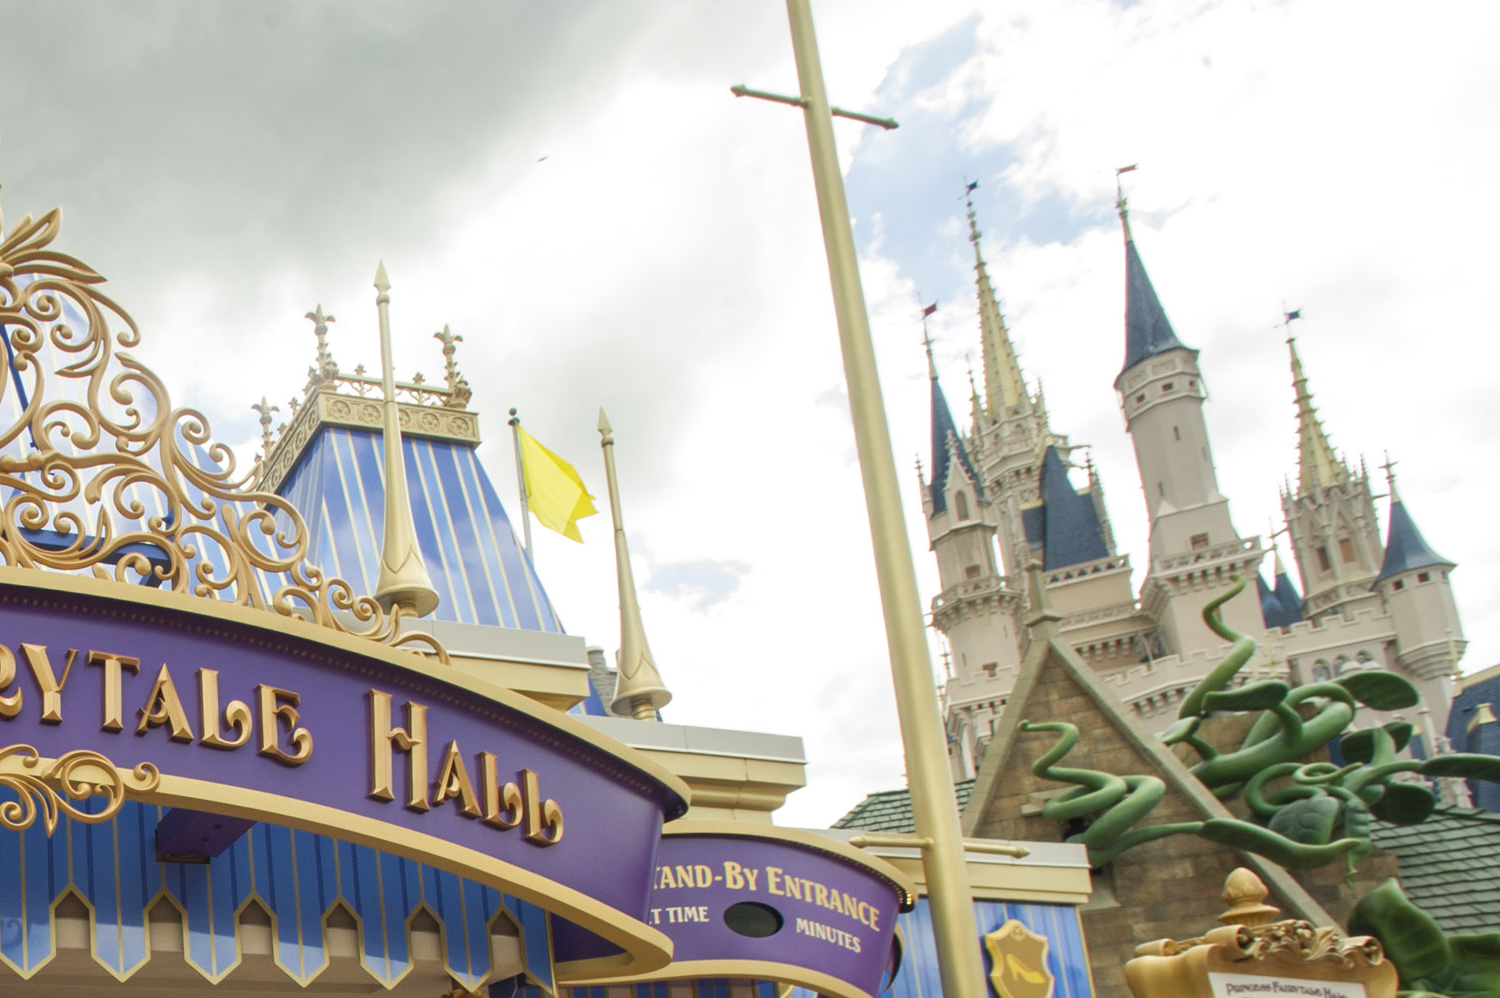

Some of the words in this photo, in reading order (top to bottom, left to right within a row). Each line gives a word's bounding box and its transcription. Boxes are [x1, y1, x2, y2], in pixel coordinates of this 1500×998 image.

[366, 688, 564, 848] HALL
[653, 861, 758, 891] AND-BY
[765, 866, 880, 932] ENTRANCE
[666, 906, 710, 924] TIME
[796, 917, 861, 953] MINUTES
